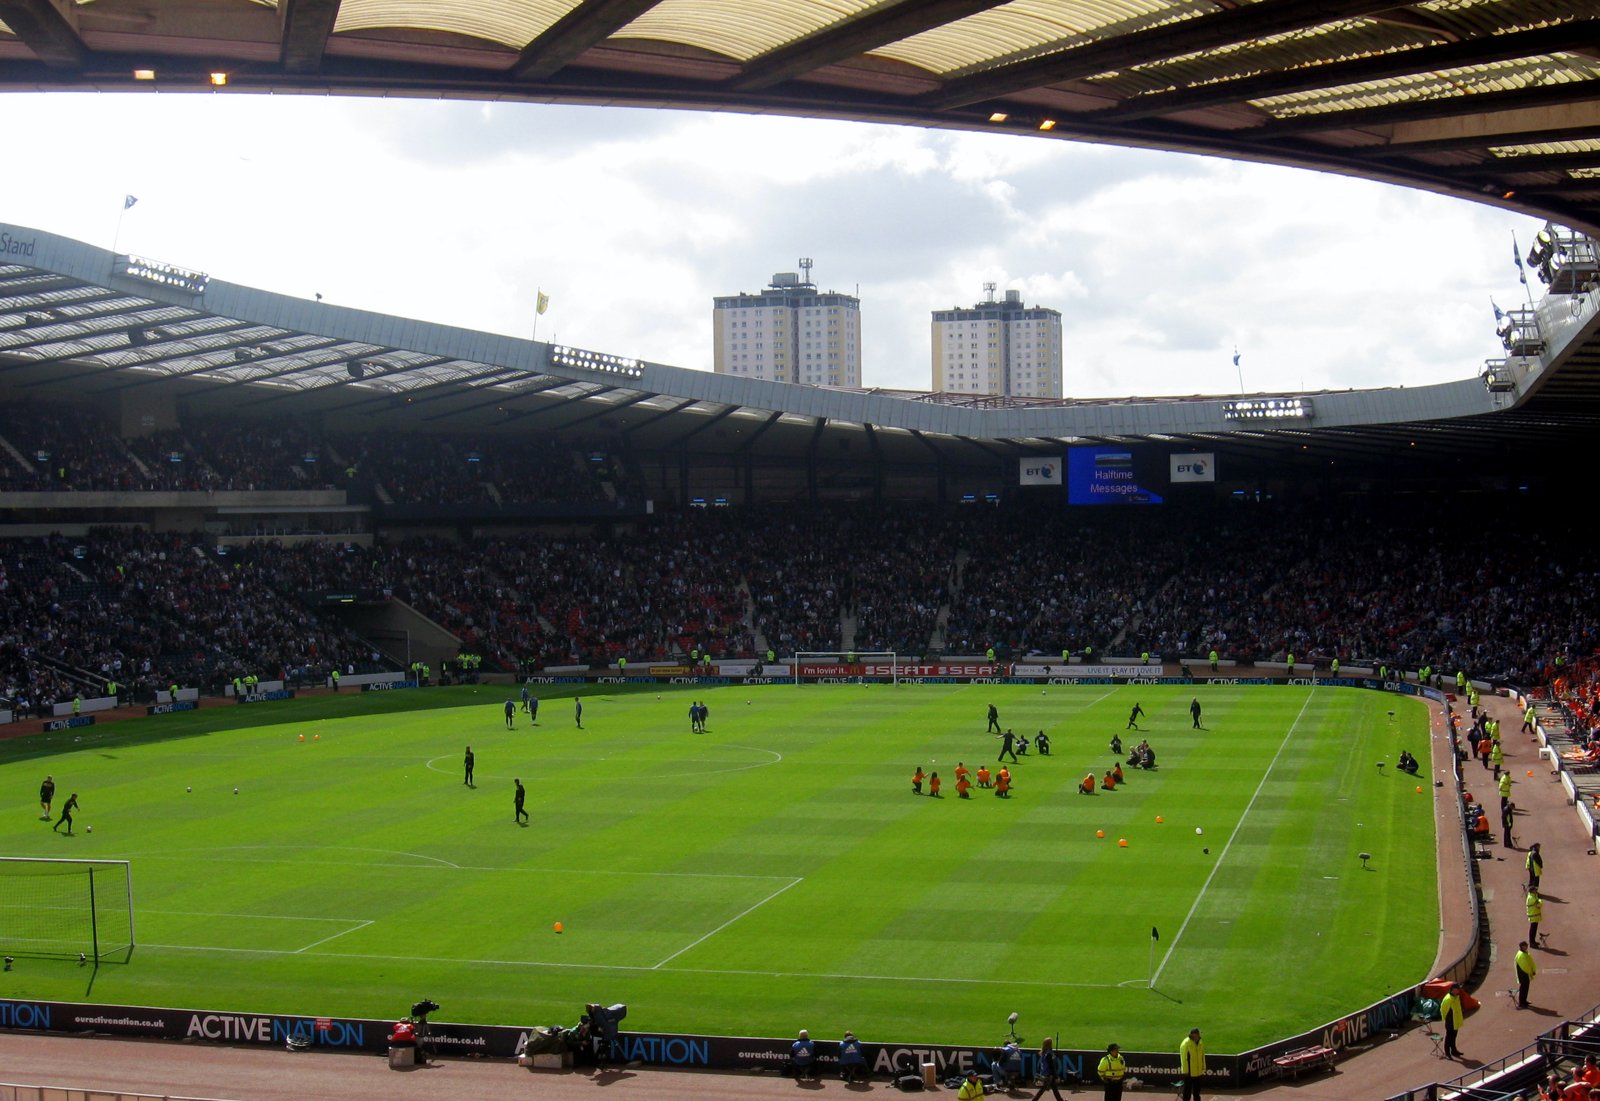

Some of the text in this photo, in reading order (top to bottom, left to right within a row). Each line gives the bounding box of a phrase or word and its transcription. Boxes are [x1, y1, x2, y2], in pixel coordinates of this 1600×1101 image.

[0, 232, 36, 257] Stand
[1026, 468, 1041, 476] BT
[1177, 464, 1193, 473] BT
[1095, 470, 1133, 479] Halftime
[1090, 484, 1138, 495] Messages
[74, 1016, 165, 1028] ouractivenation.co.uk
